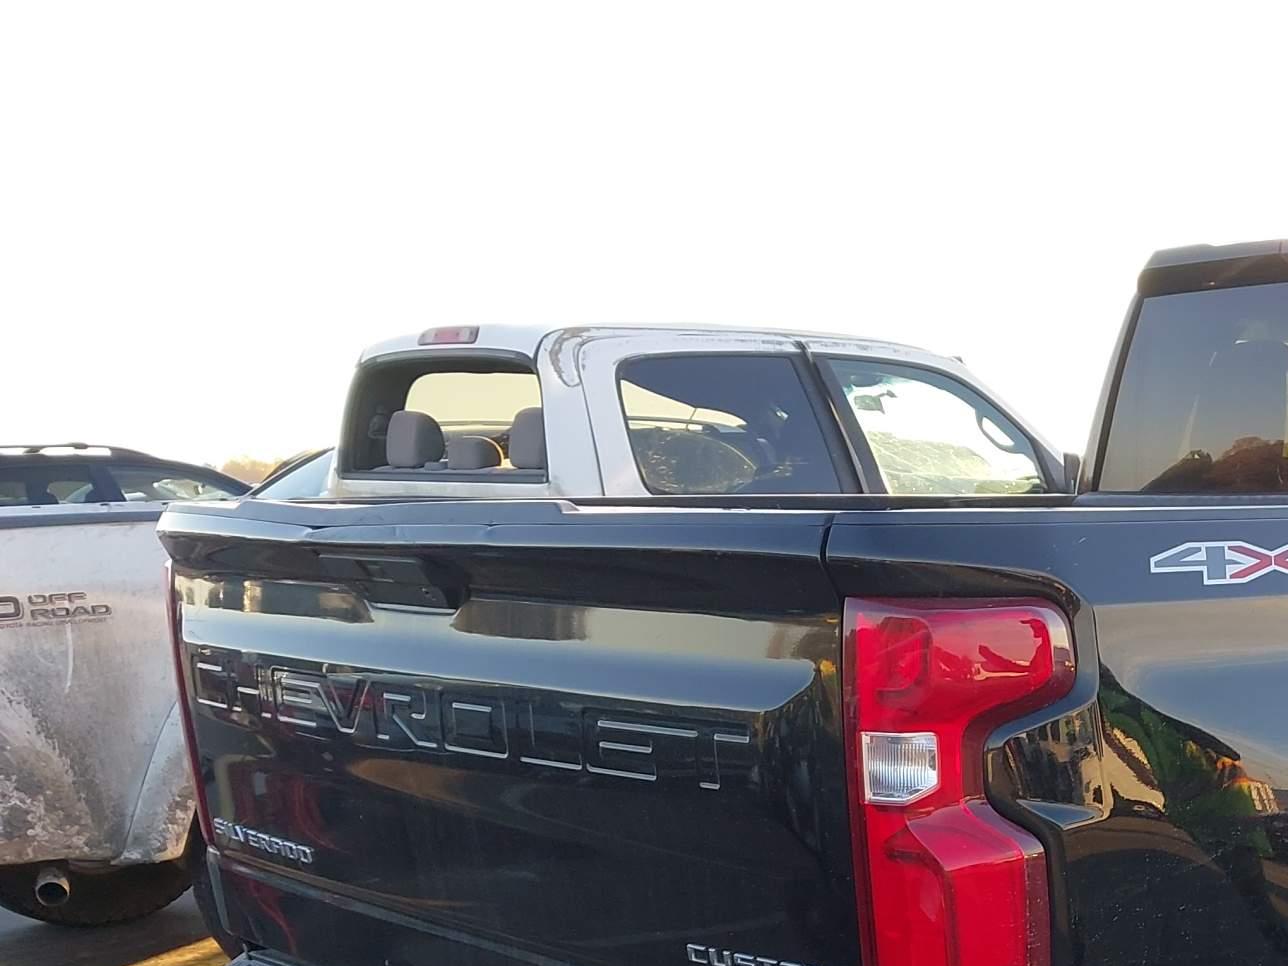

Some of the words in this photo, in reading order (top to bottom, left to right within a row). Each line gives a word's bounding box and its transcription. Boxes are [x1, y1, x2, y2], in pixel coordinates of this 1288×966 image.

[27, 592, 87, 606] OFF
[30, 604, 112, 620] ROAD
[194, 655, 751, 789] CHEVROLET
[213, 817, 314, 865] SILVERADO
